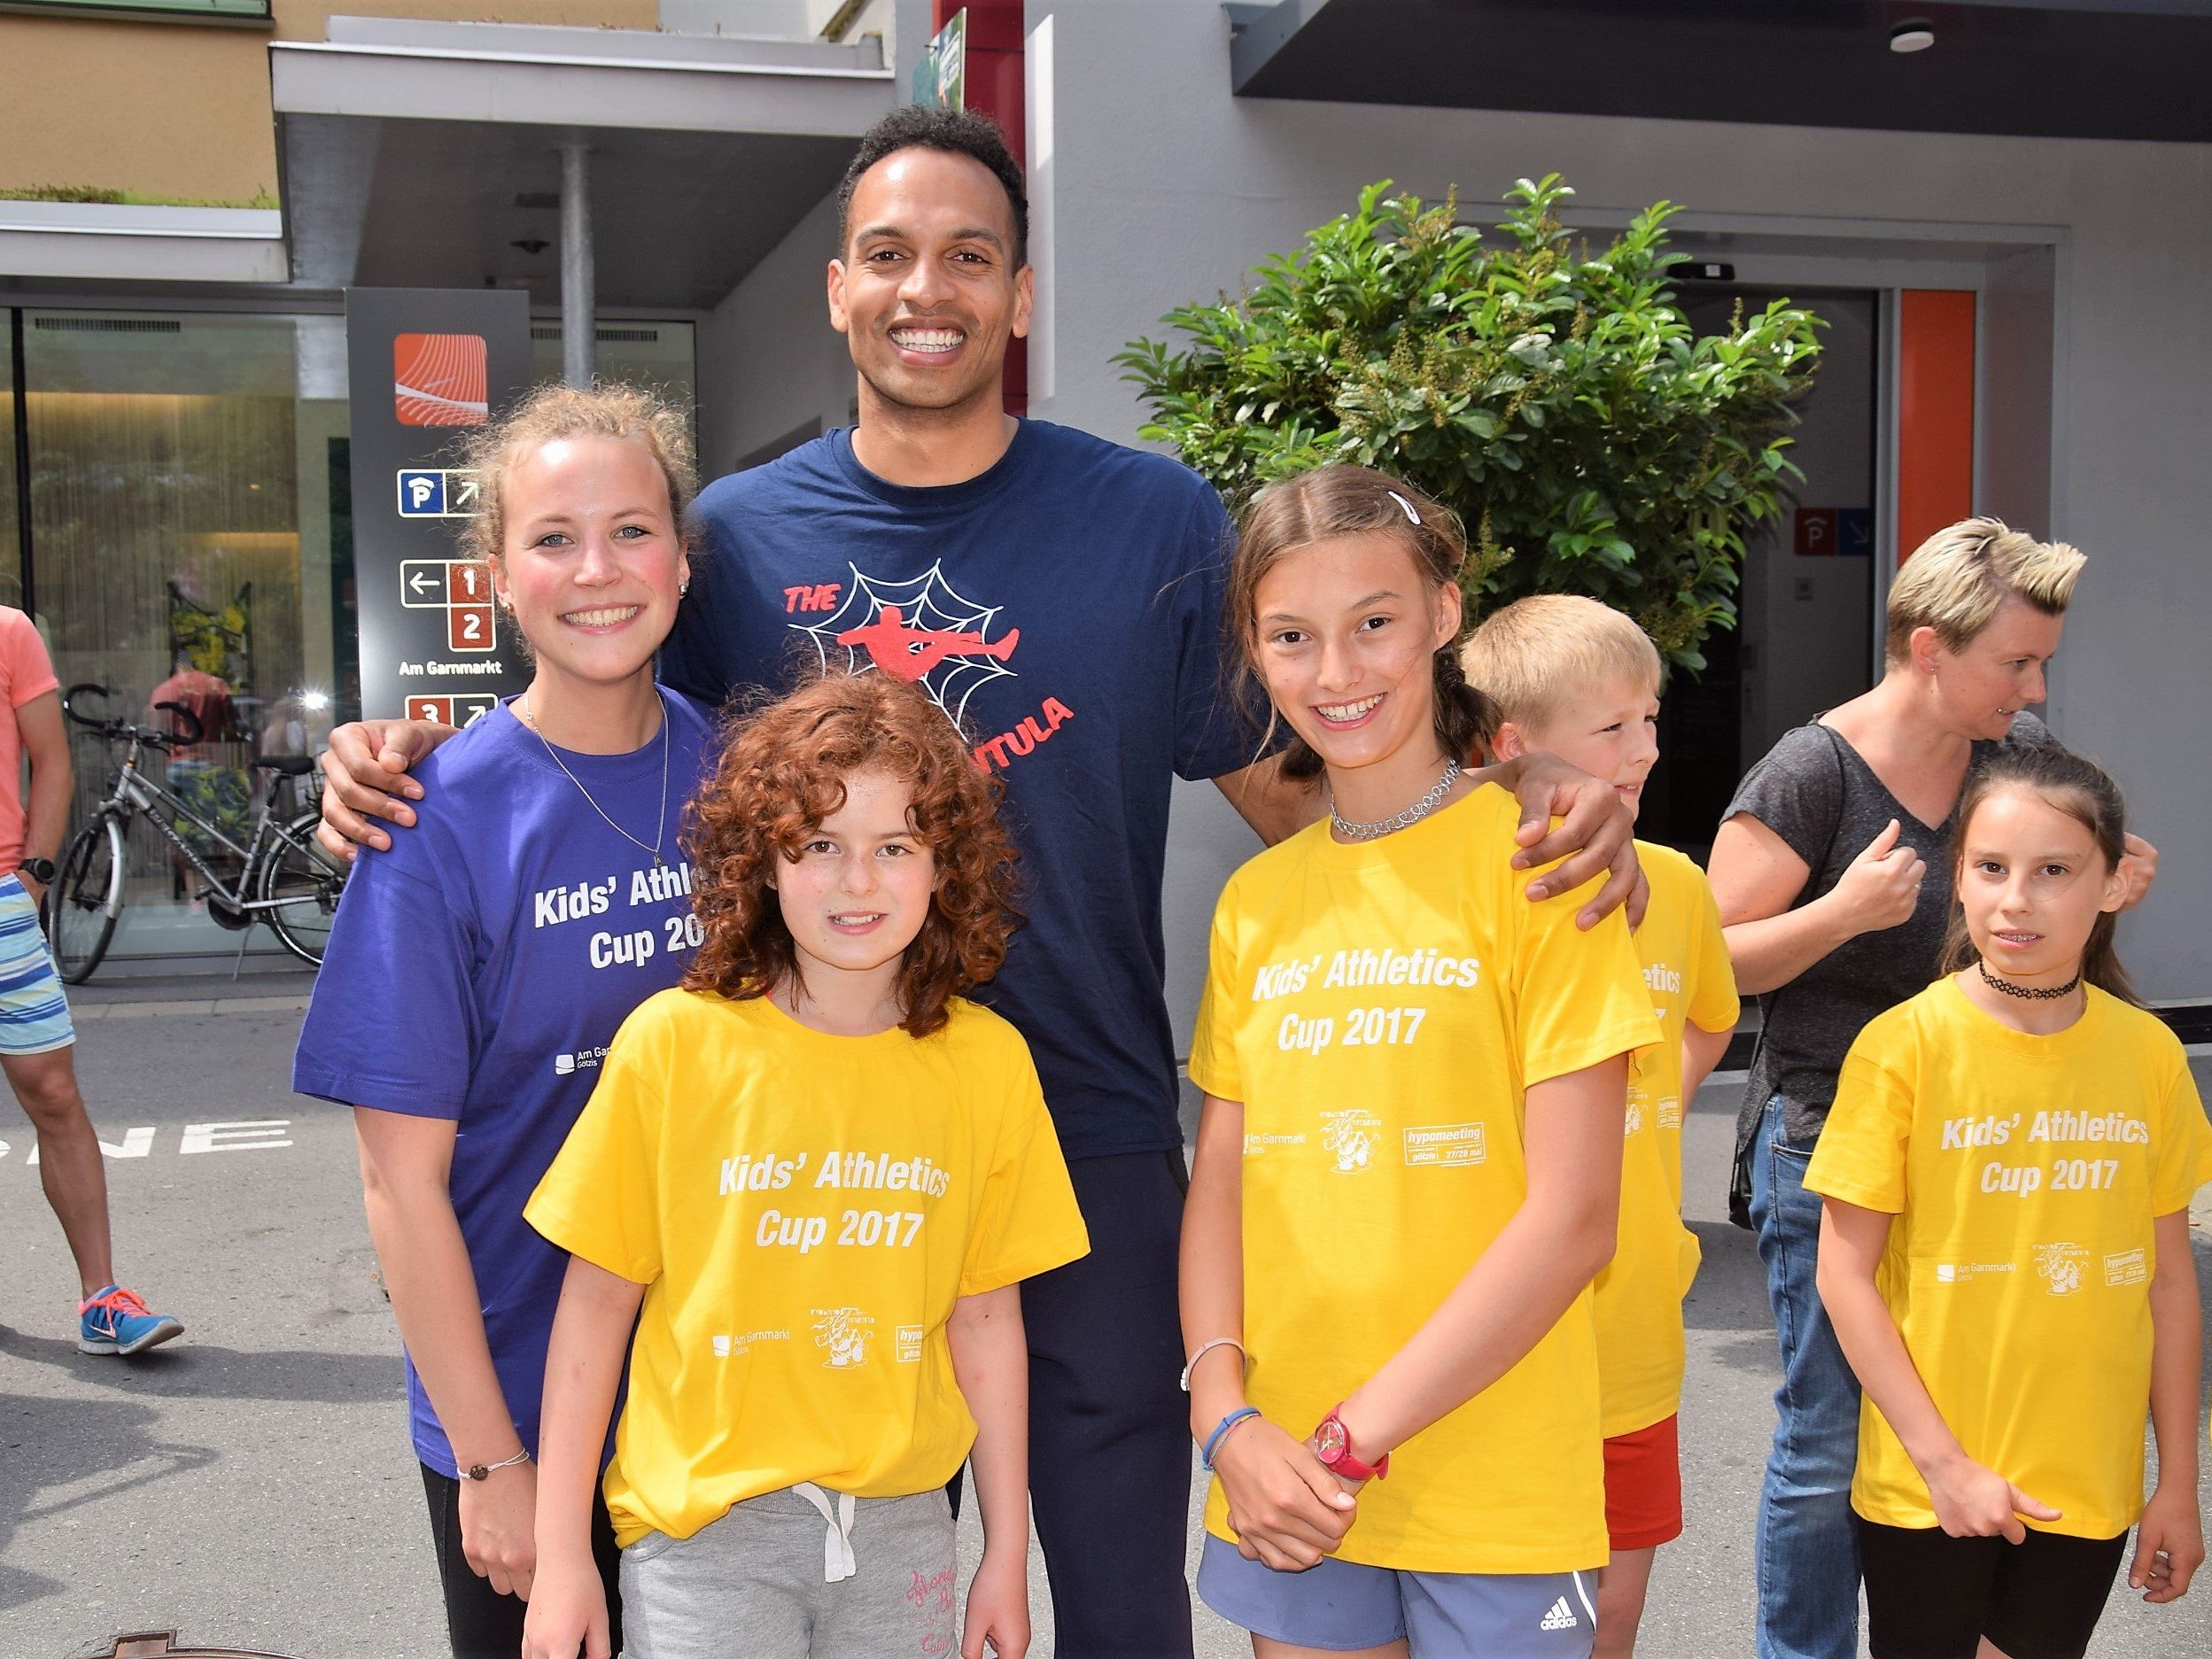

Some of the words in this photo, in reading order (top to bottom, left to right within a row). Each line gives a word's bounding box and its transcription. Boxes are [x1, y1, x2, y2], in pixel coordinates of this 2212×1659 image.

[463, 569, 475, 595] 1
[784, 584, 842, 614] THE
[463, 613, 481, 640] 2
[399, 662, 423, 676] Am
[427, 660, 502, 676] Garnmarkt
[422, 703, 439, 724] 3
[967, 696, 1075, 775] NTULA
[629, 863, 693, 906] Athl
[589, 930, 655, 969] Cup
[664, 913, 705, 952] 20
[1323, 949, 1480, 988] Athletics
[1642, 963, 1680, 994] etics
[1277, 1013, 1333, 1055] Cup
[1342, 1007, 1425, 1045] 2017
[577, 1059, 598, 1068] Götzis
[578, 1050, 593, 1061] Am
[594, 1047, 611, 1057] Gar
[0, 1120, 295, 1165] NE
[1408, 1127, 1481, 1144] hypomeeting
[2028, 1111, 2149, 1144] Athletics
[814, 1151, 951, 1198] Athletics
[1981, 1162, 2041, 1198] Cup
[2050, 1159, 2119, 1190] 2017
[756, 1209, 827, 1254] Cup
[836, 1209, 925, 1247] 2017
[747, 1330, 790, 1342] Garnmarkt
[1540, 1616, 1578, 1631] adidas
